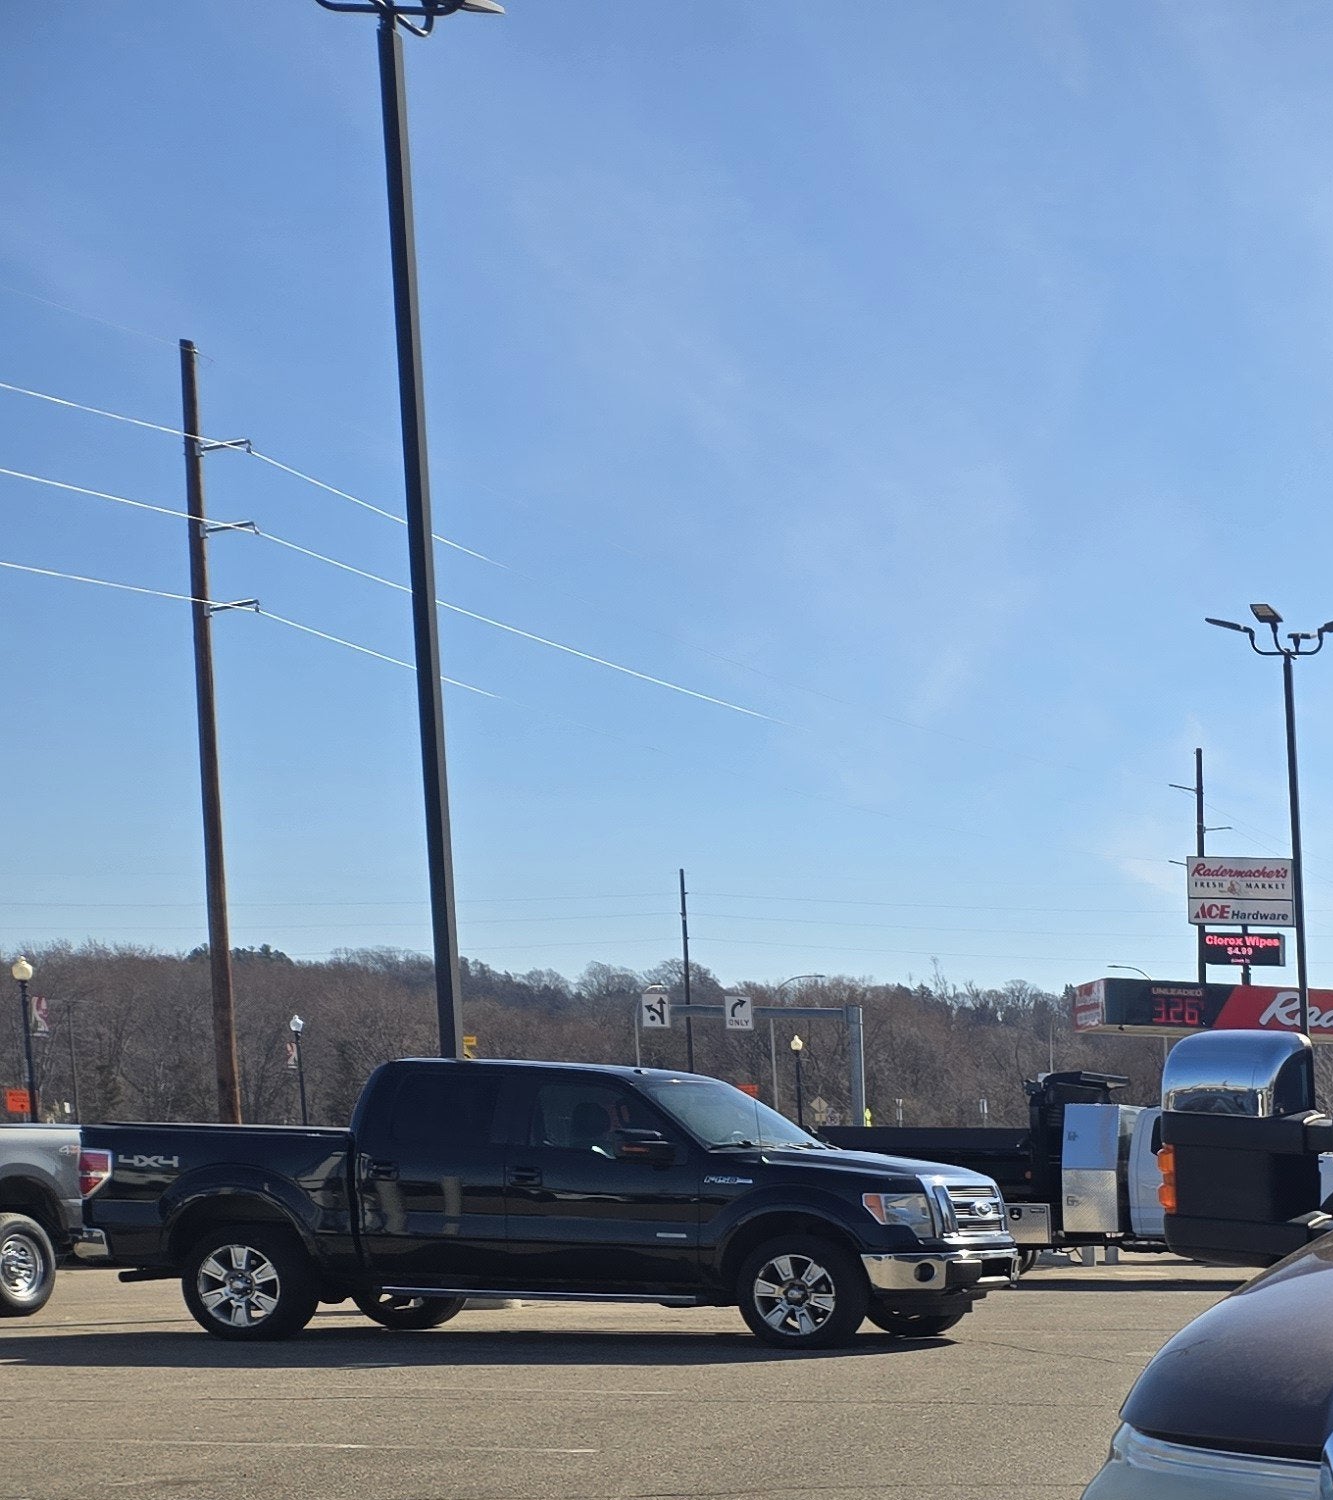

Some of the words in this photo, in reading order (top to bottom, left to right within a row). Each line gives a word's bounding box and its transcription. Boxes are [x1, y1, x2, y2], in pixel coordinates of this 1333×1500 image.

[1191, 863, 1288, 879] Radermacher's
[1194, 902, 1231, 920] ACE
[1231, 910, 1288, 921] Hardware
[1205, 935, 1243, 946] Clorox
[1244, 936, 1280, 948] Wipes
[1227, 947, 1253, 956] $4.99
[1152, 987, 1203, 997] UNLEADED
[1152, 999, 1200, 1024] 326
